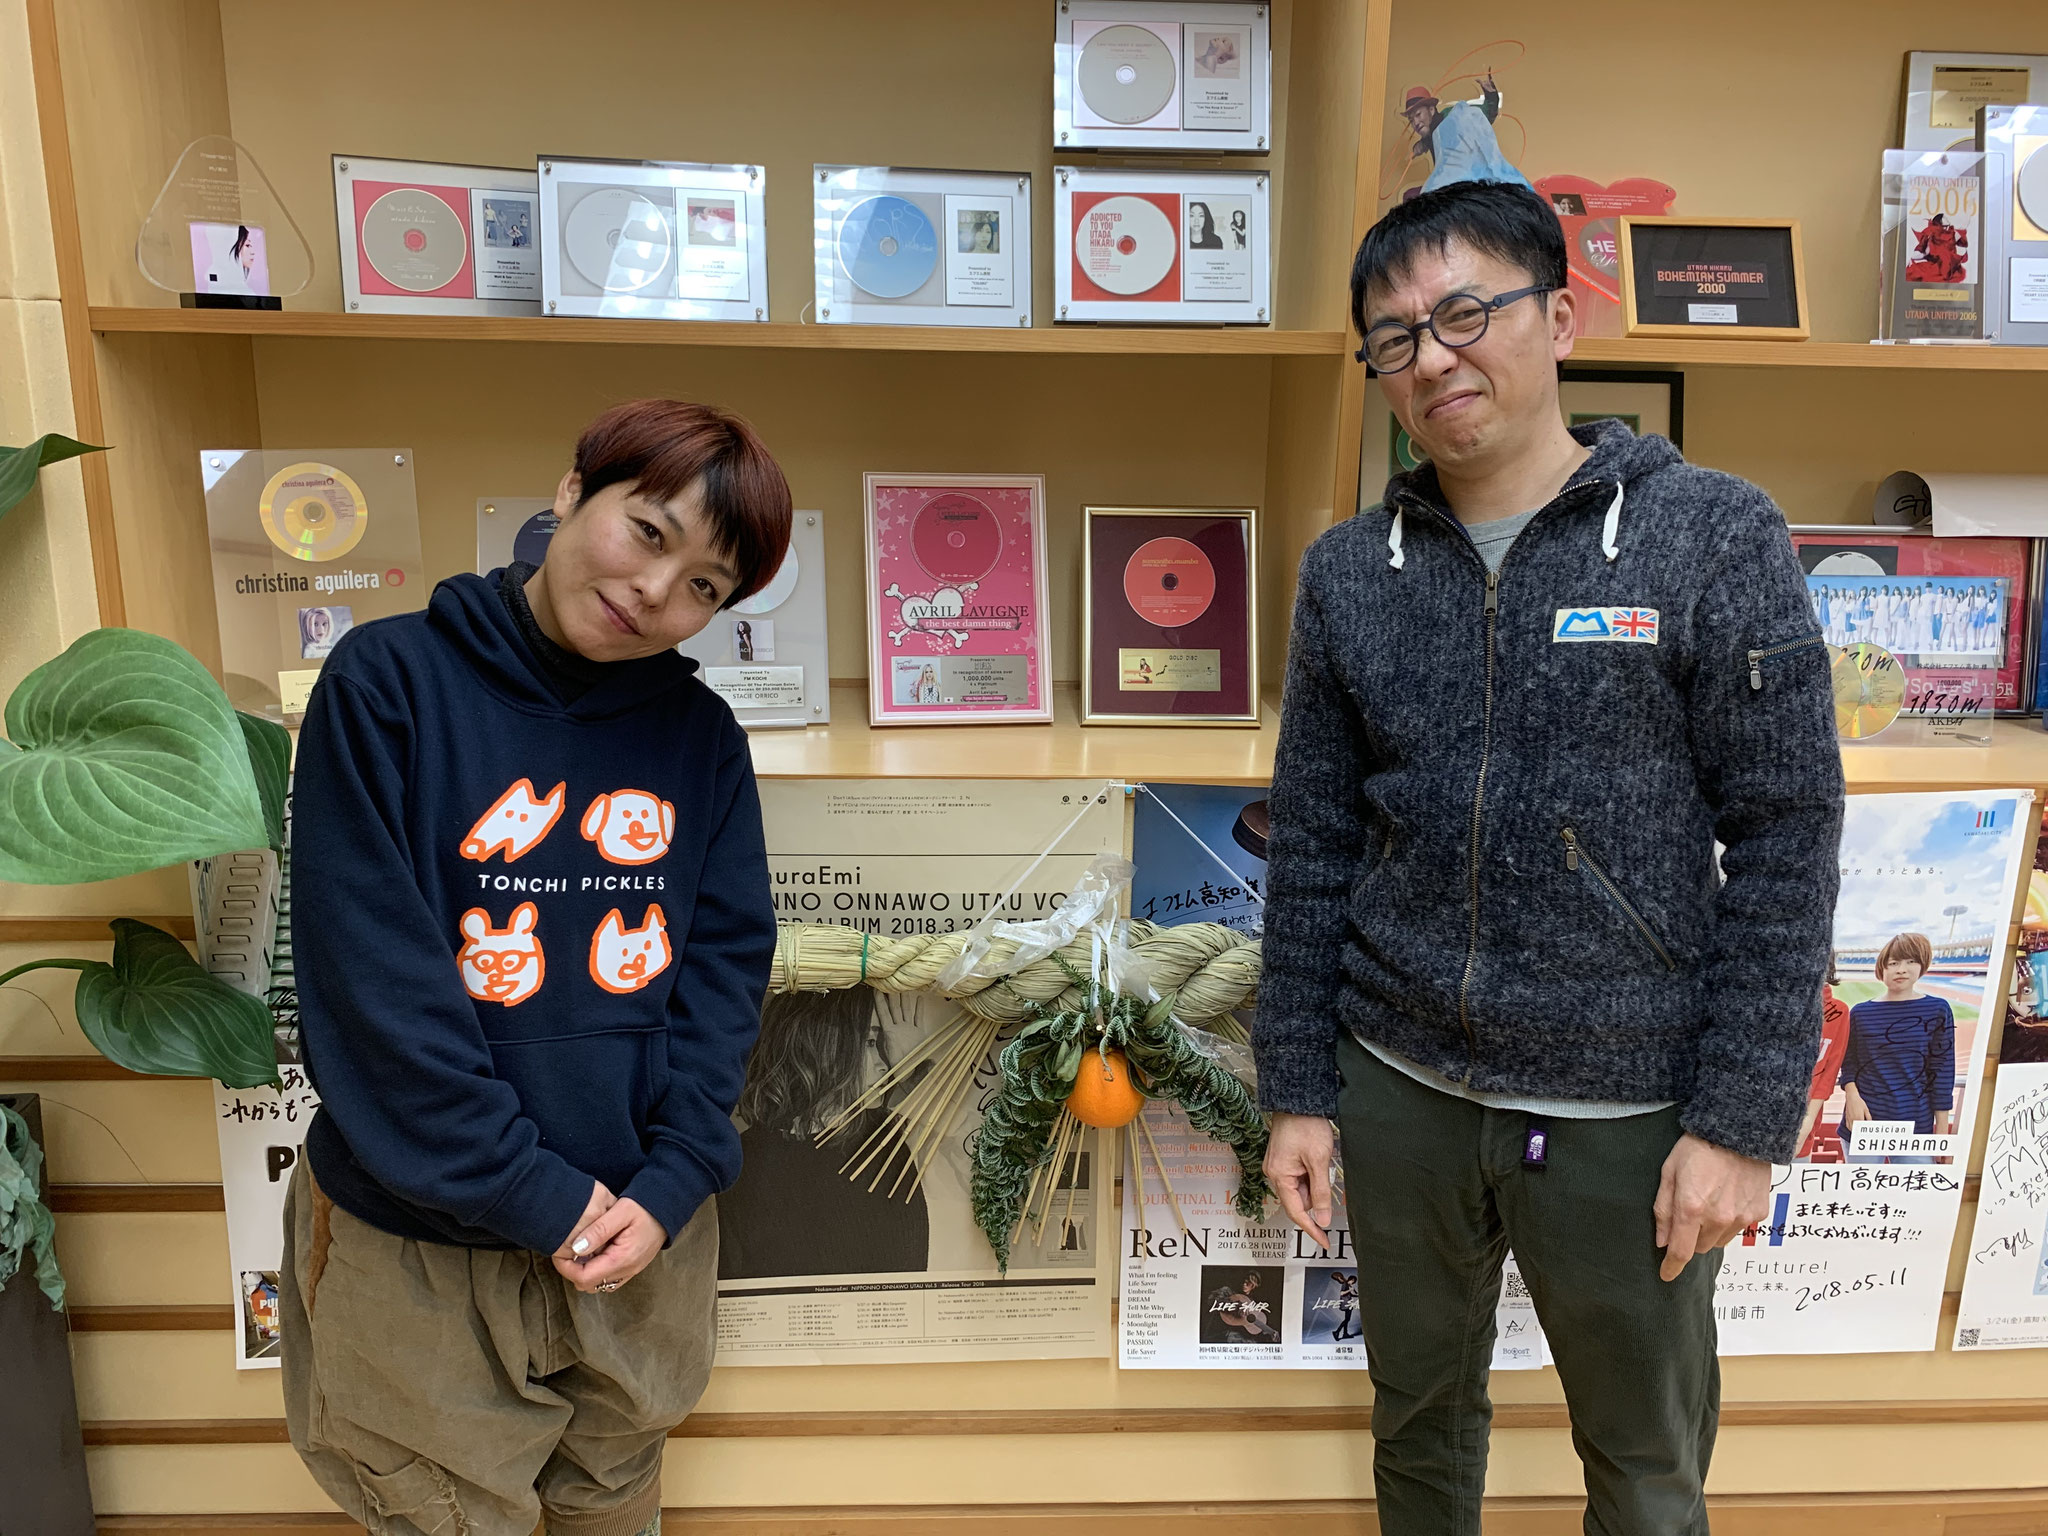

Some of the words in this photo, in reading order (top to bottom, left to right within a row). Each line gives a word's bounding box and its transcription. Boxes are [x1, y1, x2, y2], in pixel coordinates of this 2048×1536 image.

[1909, 176, 1940, 186] UTADA
[1943, 177, 1978, 188] UNITED
[1909, 186, 1977, 216] 2006
[1090, 212, 1122, 222] ADDICTED
[1090, 222, 1098, 230] TO
[1100, 222, 1114, 230] YOU
[1090, 230, 1112, 239] UTADA
[1090, 238, 1115, 248] HIKARU
[1656, 270, 1714, 282] BOHEMIAN
[1716, 272, 1764, 283] SUMMER
[1696, 283, 1726, 294] 2000
[1905, 310, 1929, 320] UTADA
[1931, 312, 1958, 320] UNITED
[1960, 312, 1978, 321] 2006
[236, 573, 309, 594] christina
[314, 570, 380, 595] aguilera
[909, 606, 956, 616] AVRIL
[960, 606, 1029, 616] LAVIGNE
[988, 619, 1012, 628] thing
[1909, 690, 1984, 714] 1830m
[478, 874, 568, 892] TONCHI
[582, 876, 665, 891] PICKLES
[834, 892, 950, 912] ONNAWO
[962, 893, 1022, 911] UTAU
[1860, 1125, 1906, 1134] musician
[1858, 1139, 1949, 1151] SHISHAMO
[268, 1144, 303, 1182] P
[1800, 1168, 1840, 1192] FM
[1850, 1167, 1928, 1192] 高知様
[1174, 1194, 1216, 1206] FINAL
[1795, 1202, 1907, 1218] また来たいです!!!
[1218, 1228, 1240, 1238] 2nd
[1244, 1228, 1286, 1238] ALBUM
[1128, 1228, 1211, 1258] ReN
[1218, 1242, 1259, 1250] 2017.6.28
[1261, 1242, 1286, 1250] (WED)
[1722, 1264, 1737, 1276] s,
[1745, 1260, 1828, 1274] Future!
[1209, 1300, 1239, 1313] LIFE
[1240, 1300, 1272, 1314] SAVER
[1312, 1298, 1344, 1310] LIFE
[1715, 1305, 1765, 1320] 川崎市
